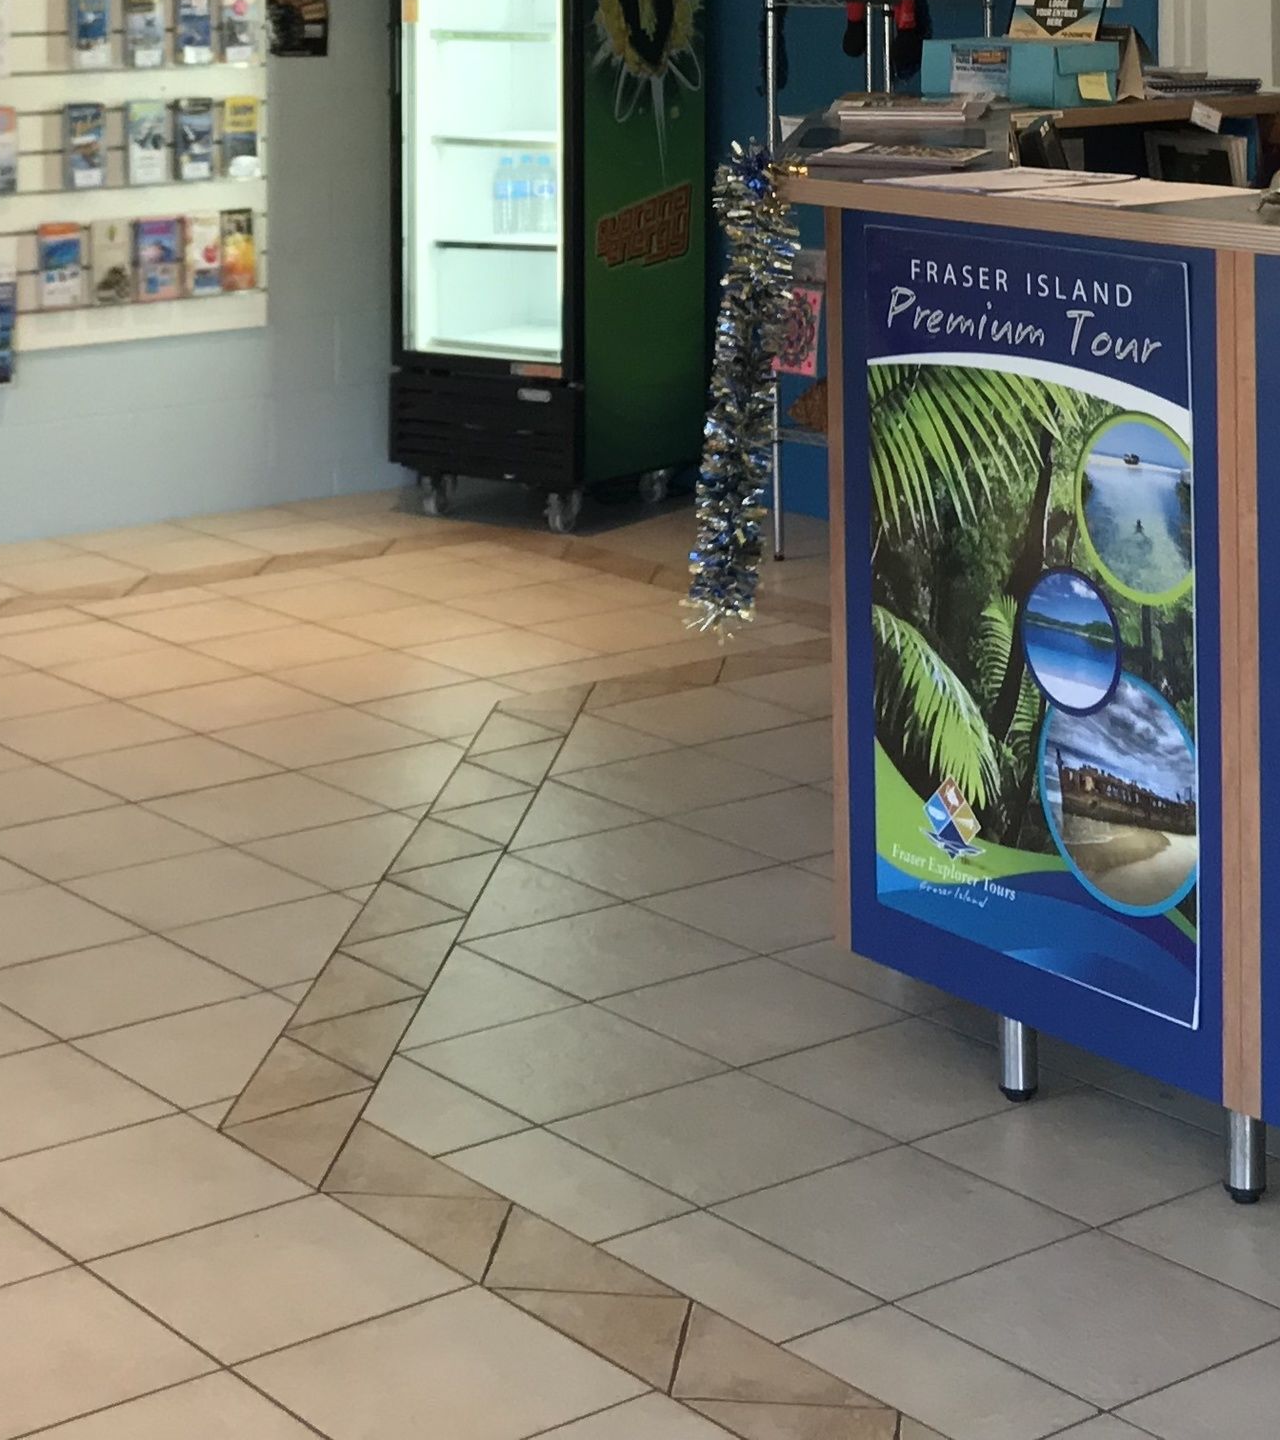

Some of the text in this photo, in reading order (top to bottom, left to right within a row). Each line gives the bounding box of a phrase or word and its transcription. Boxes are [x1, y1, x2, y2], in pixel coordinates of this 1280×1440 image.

[1035, 8, 1078, 18] YOUR ENTRIES
[1048, 0, 1069, 9] LODGE
[1046, 18, 1063, 27] HERE
[910, 258, 1133, 308] FRASER ISLAND
[887, 285, 1163, 364] Premium Tour
[891, 843, 1017, 902] Fraser Explorer Tours
[919, 880, 989, 909] Fraser Island
